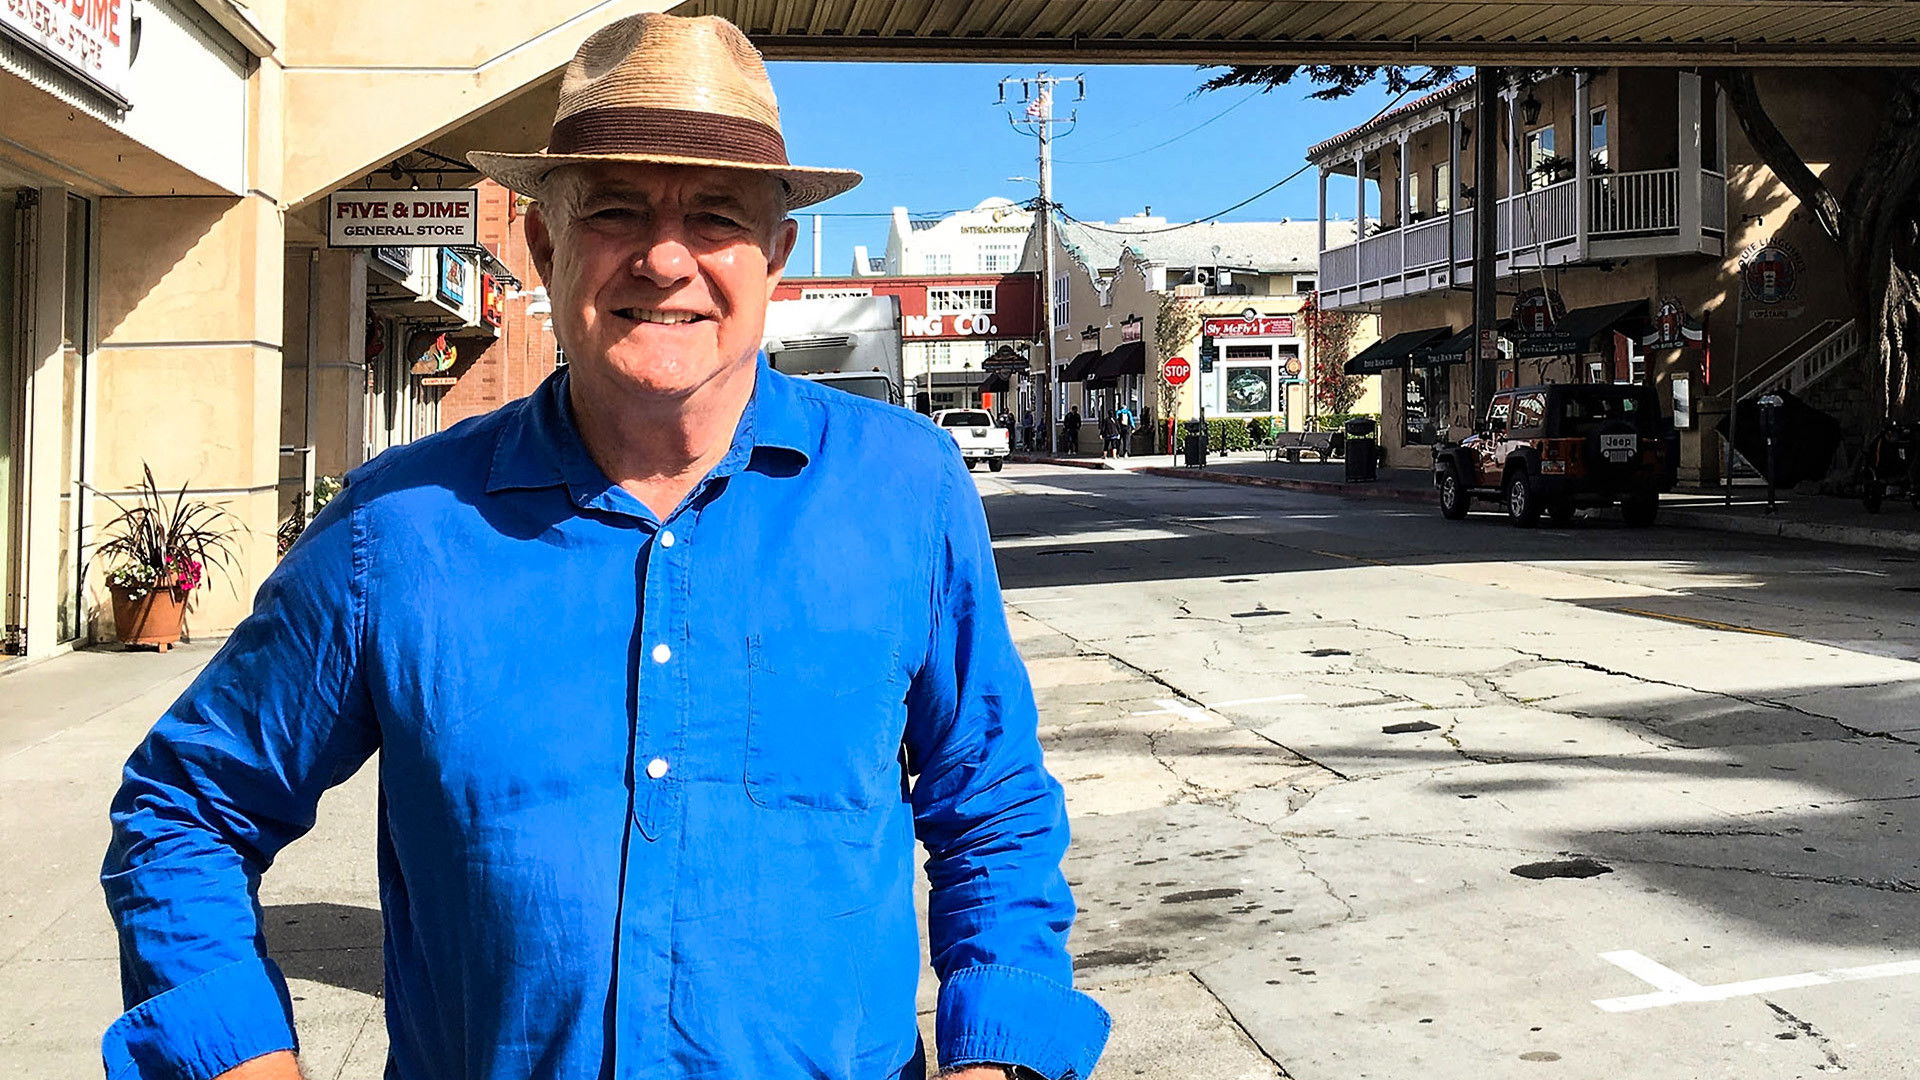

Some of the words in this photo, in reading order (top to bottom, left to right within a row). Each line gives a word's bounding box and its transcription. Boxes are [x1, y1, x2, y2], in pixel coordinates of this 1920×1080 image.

[69, 24, 103, 69] STORE
[337, 202, 388, 219] FIVE
[392, 202, 409, 218] &
[413, 201, 470, 218] DIME
[344, 225, 414, 236] GENERAL
[417, 225, 464, 236] STORE
[961, 225, 1031, 234] INTERCONTINENTA
[1438, 274, 1447, 284] 660
[954, 315, 998, 336] CO.
[1206, 323, 1221, 334] Sly
[1223, 323, 1258, 333] McFly's
[1165, 365, 1190, 377] STOP
[1606, 437, 1631, 447] Jeep
